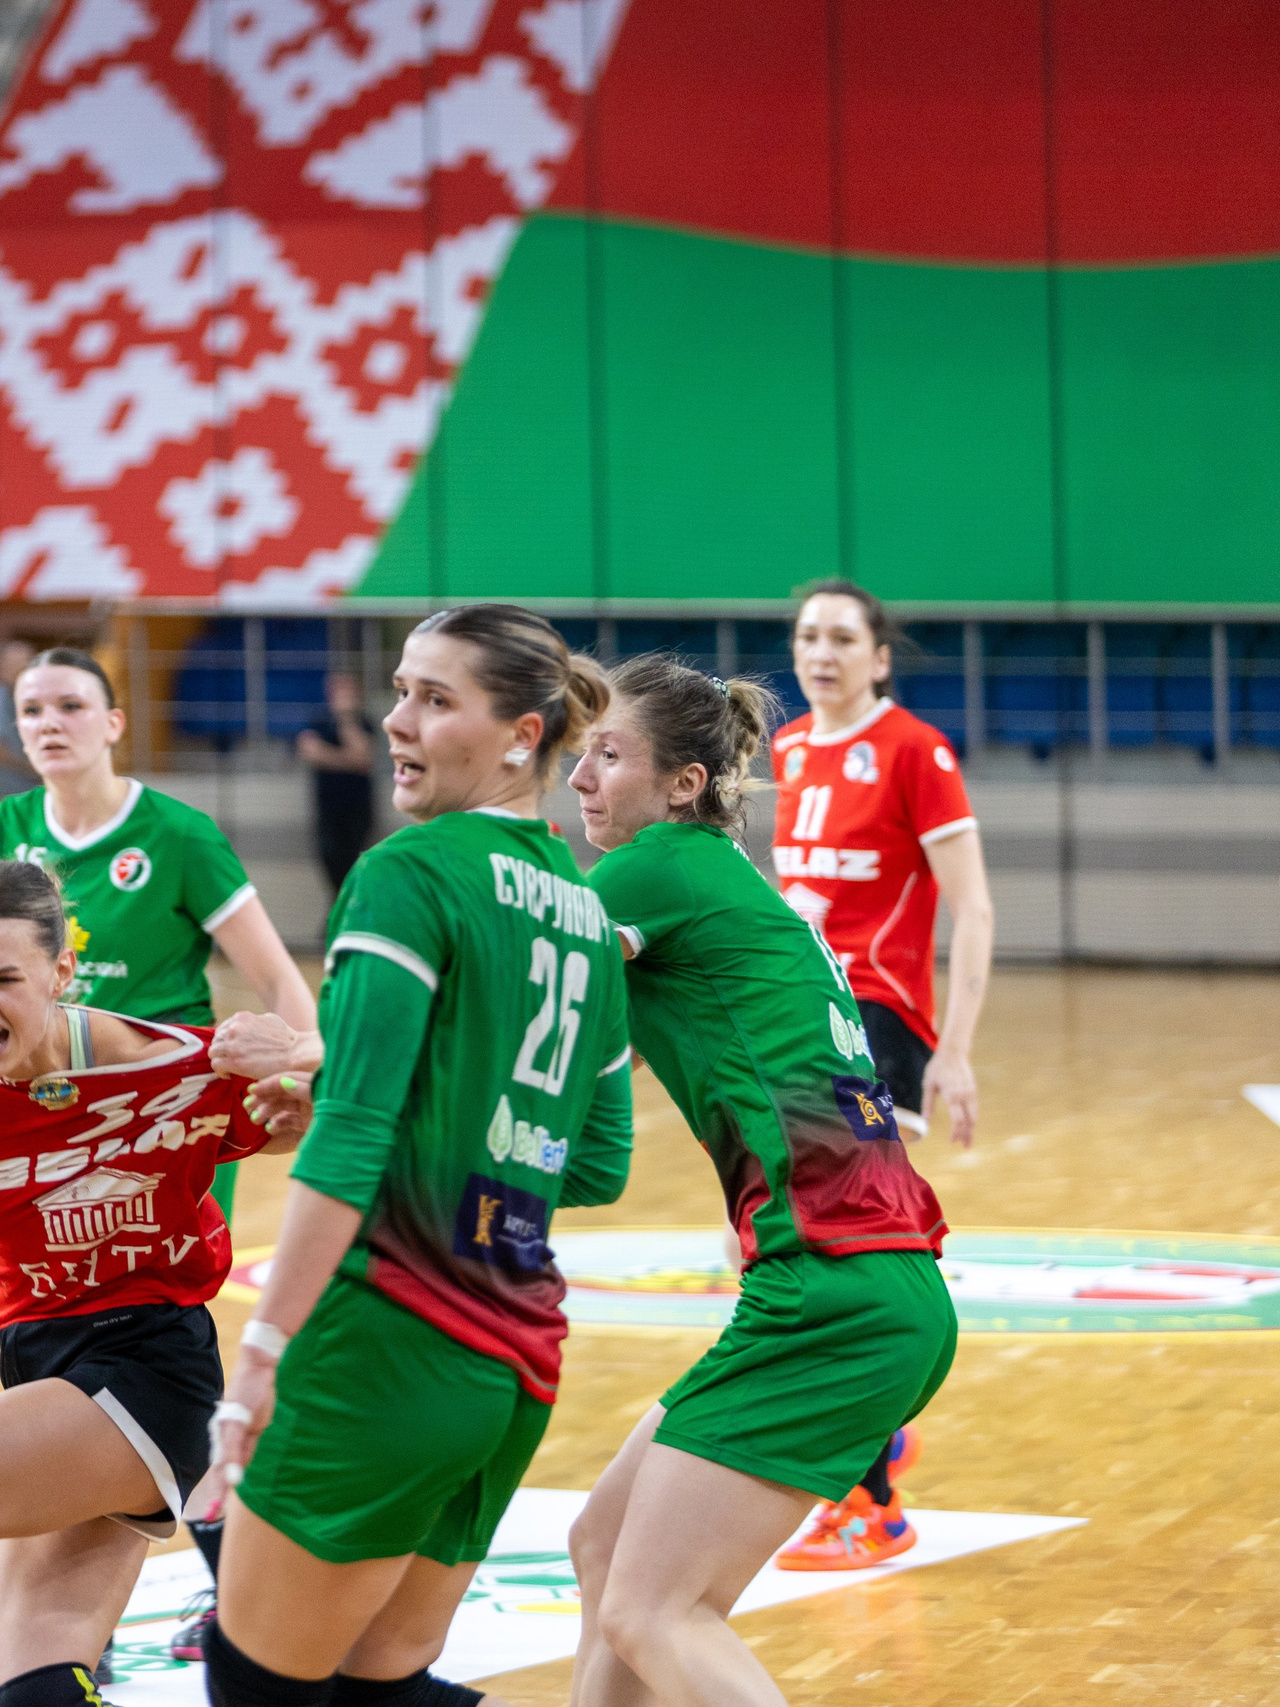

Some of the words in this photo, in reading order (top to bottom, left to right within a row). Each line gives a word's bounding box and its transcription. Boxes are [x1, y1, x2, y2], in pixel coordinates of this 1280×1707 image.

[791, 785, 833, 840] 11
[773, 845, 882, 882] ELAZ
[512, 936, 590, 1097] 26
